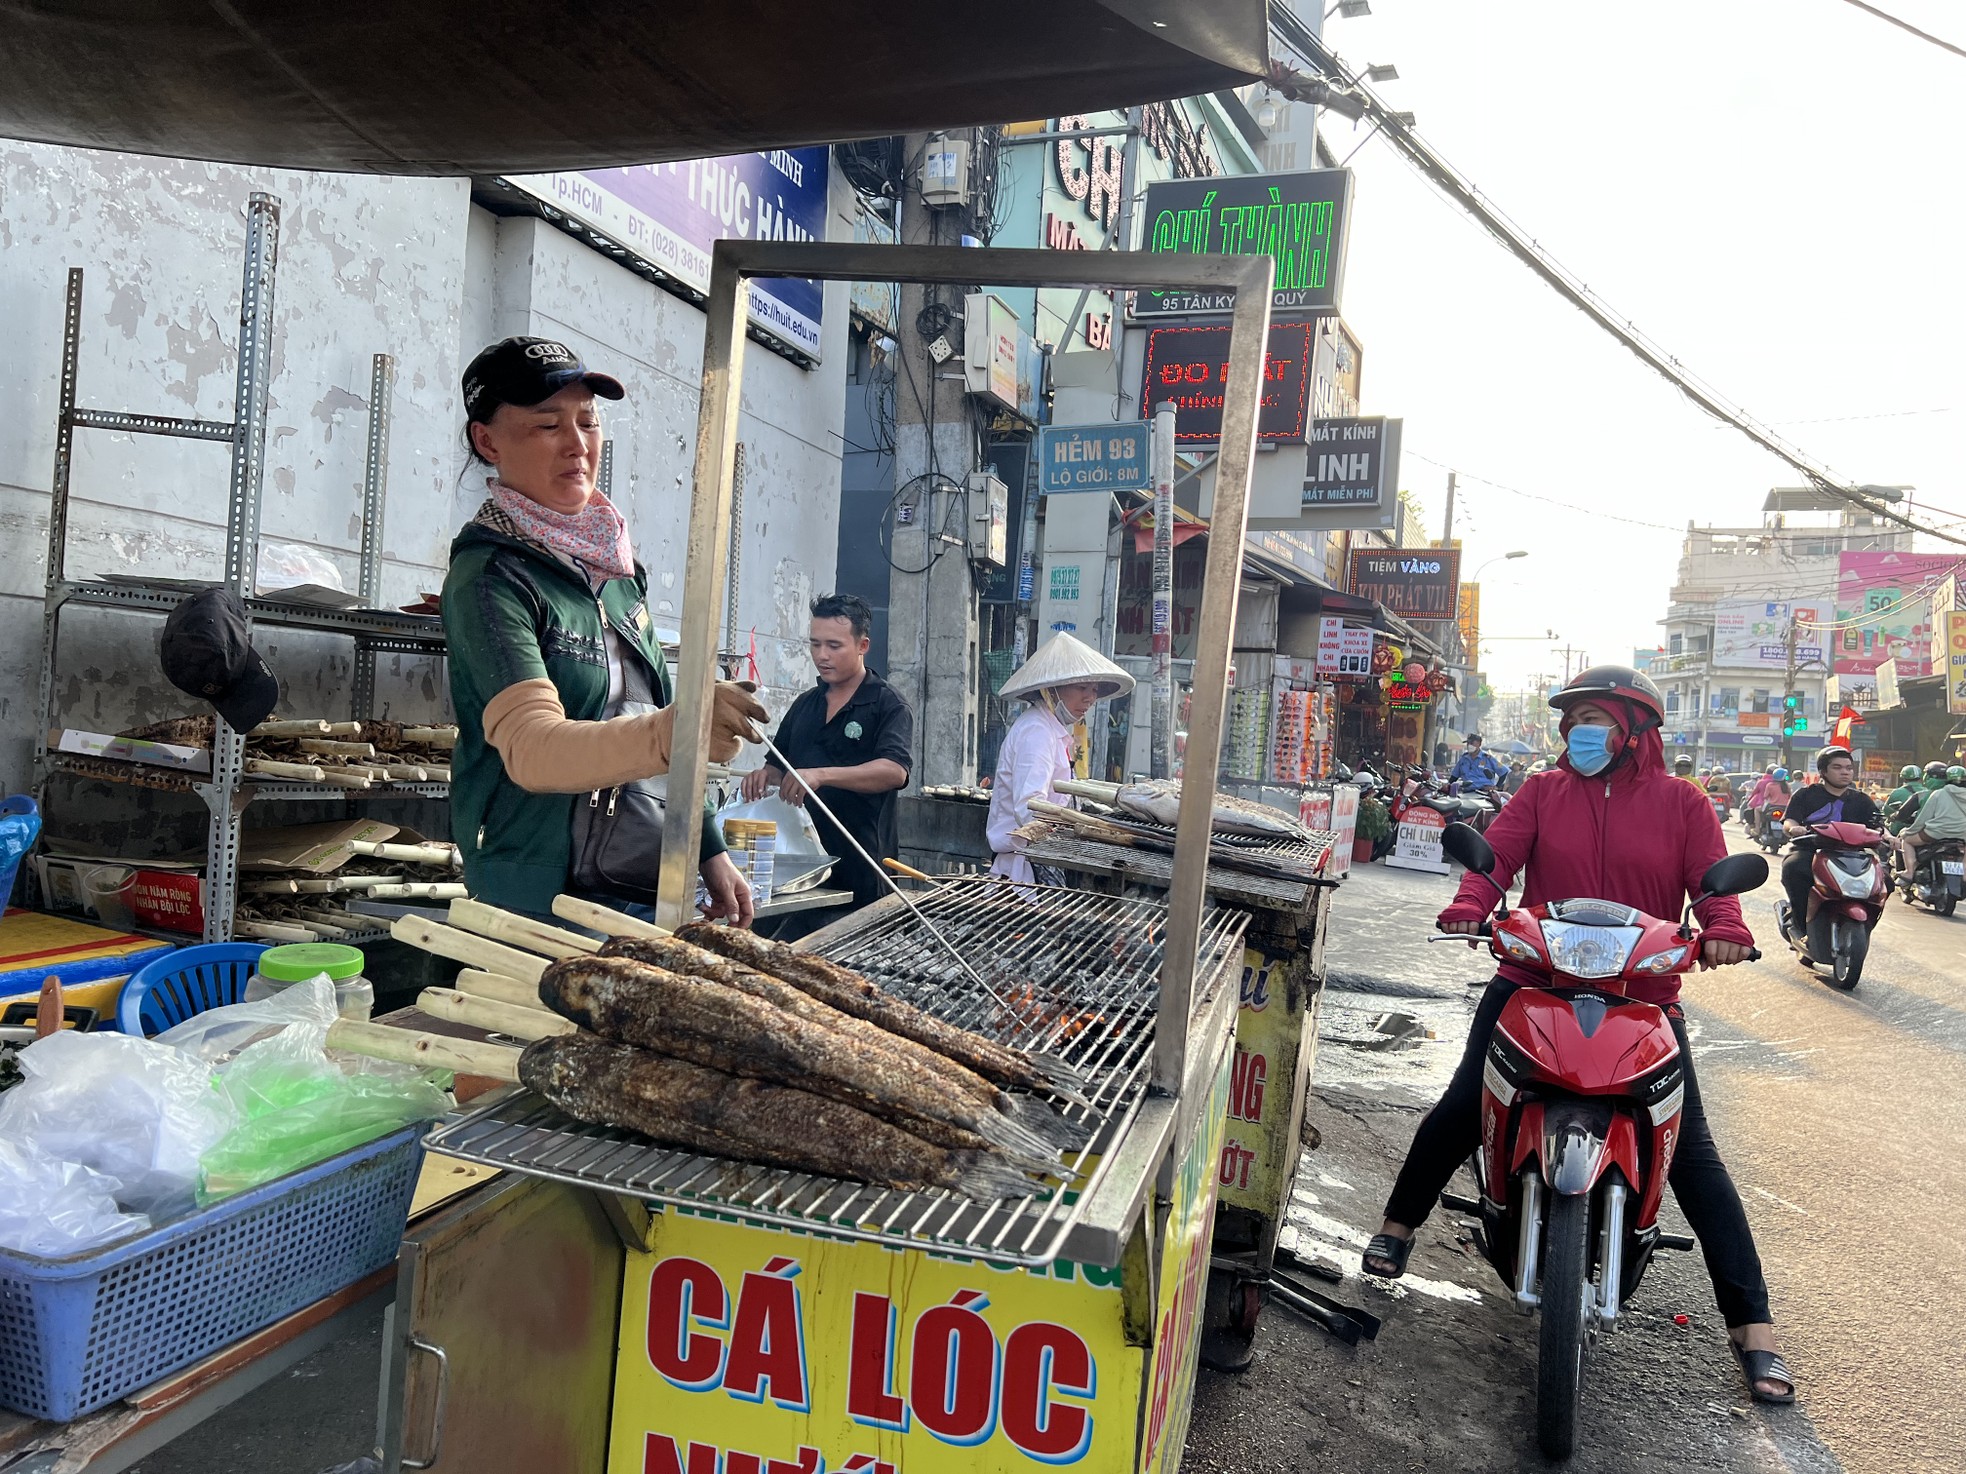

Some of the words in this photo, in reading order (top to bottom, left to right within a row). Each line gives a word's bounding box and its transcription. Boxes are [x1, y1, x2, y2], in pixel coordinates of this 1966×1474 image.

[627, 213, 649, 244] ĐT:
[652, 227, 679, 267] (028)
[1162, 297, 1178, 311] 95
[1182, 294, 1212, 309] TÂN
[1273, 289, 1307, 306] QUÝ
[1343, 424, 1376, 441] KÍNH
[1054, 433, 1101, 464] HẺM
[1109, 437, 1136, 460] 93
[1051, 466, 1072, 486] LỘ
[1076, 466, 1113, 485] GIỚI:
[1117, 467, 1139, 481] 8M
[1327, 484, 1353, 500] MIỄN
[1356, 486, 1374, 499] PHÍ
[1369, 557, 1397, 576] TIỆM
[1400, 557, 1441, 574] VÀNG
[1387, 576, 1423, 610] PHÁT
[1426, 584, 1448, 611] VII
[1400, 825, 1416, 841] CHÍ
[1419, 830, 1442, 844] LINH
[1574, 993, 1606, 1003] HONDA
[1491, 1041, 1506, 1061] TDC
[1649, 1075, 1669, 1094] TDC
[645, 1254, 811, 1414] CÁ
[845, 1287, 1098, 1467] LÓC
